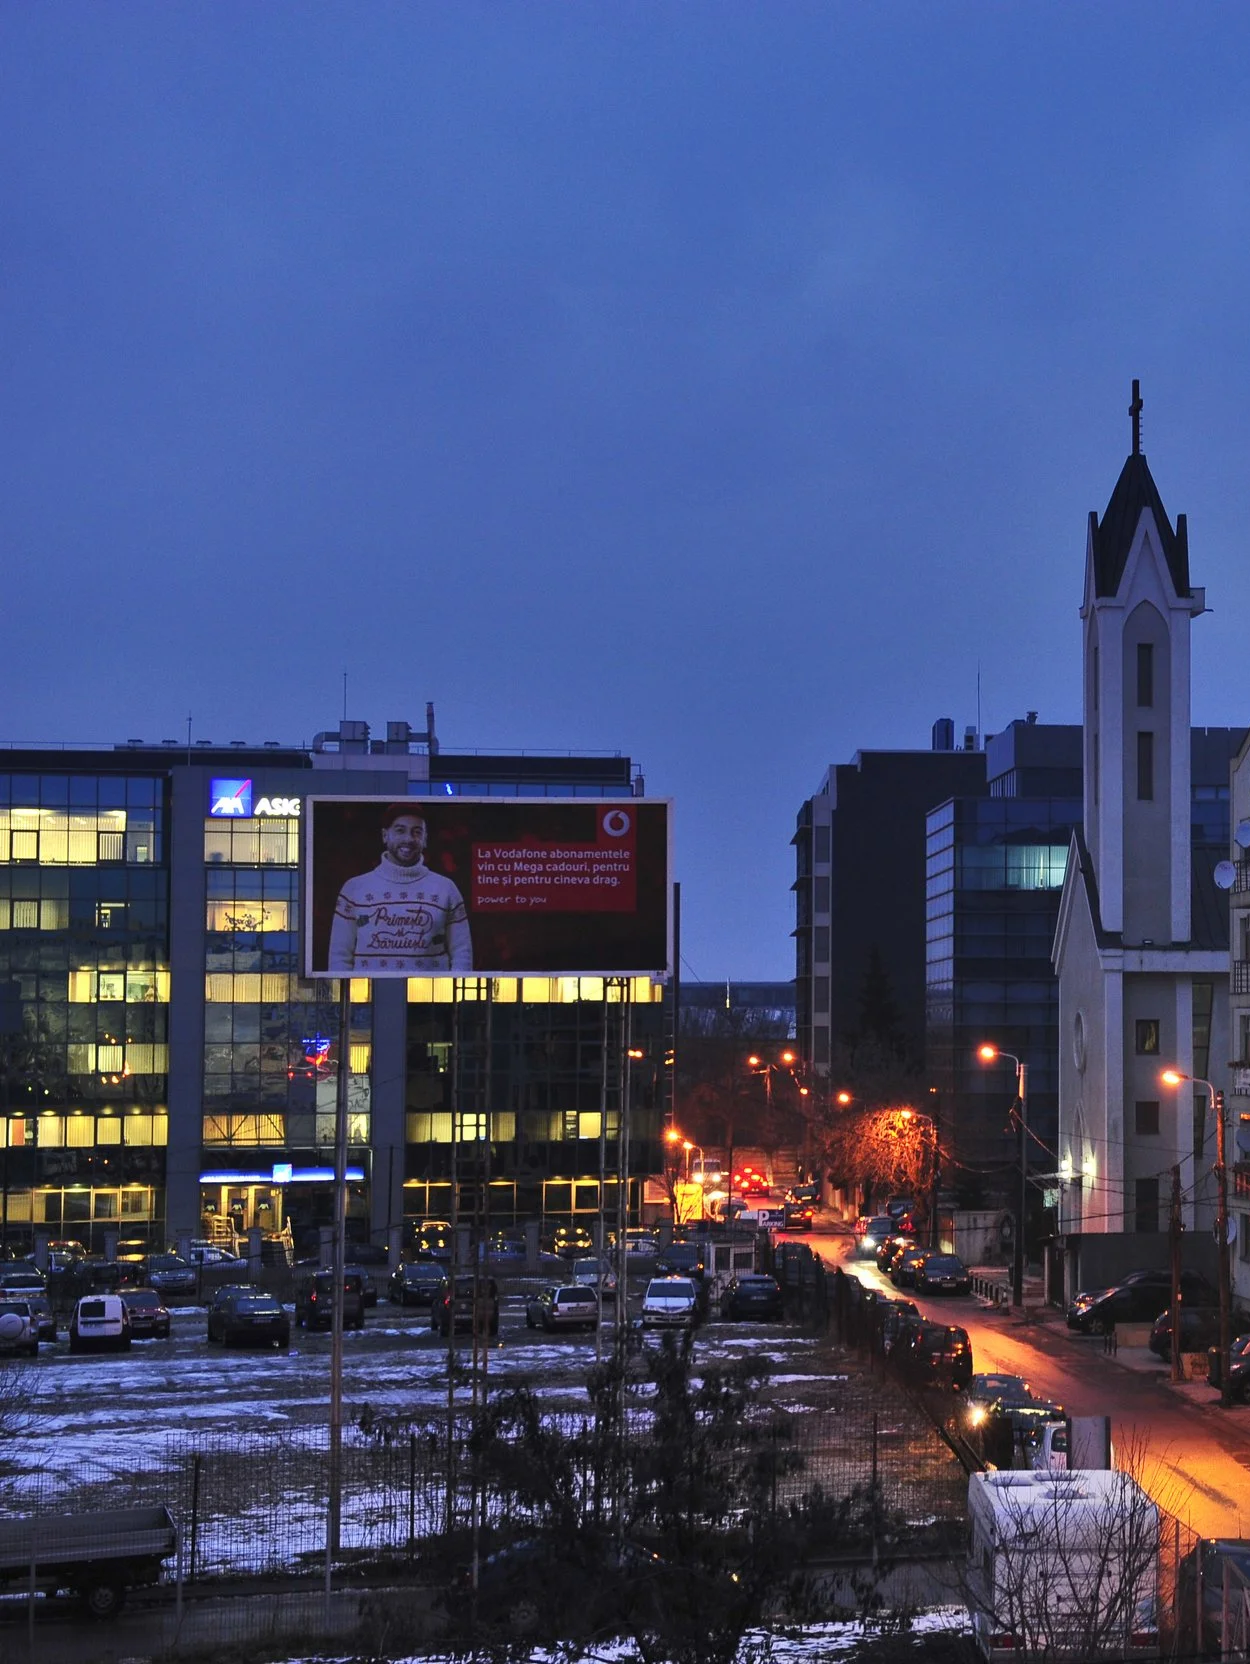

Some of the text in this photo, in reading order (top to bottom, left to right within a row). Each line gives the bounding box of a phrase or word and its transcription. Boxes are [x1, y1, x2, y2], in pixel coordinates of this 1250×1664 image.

[477, 849, 630, 859] La Vodafone abonamentele
[477, 862, 630, 874] vin cu Mega cadouri, pentru
[477, 875, 500, 885] tine
[514, 876, 551, 887] pentru
[554, 875, 590, 885] cineva
[593, 875, 621, 887] drag.
[477, 895, 547, 906] power to you
